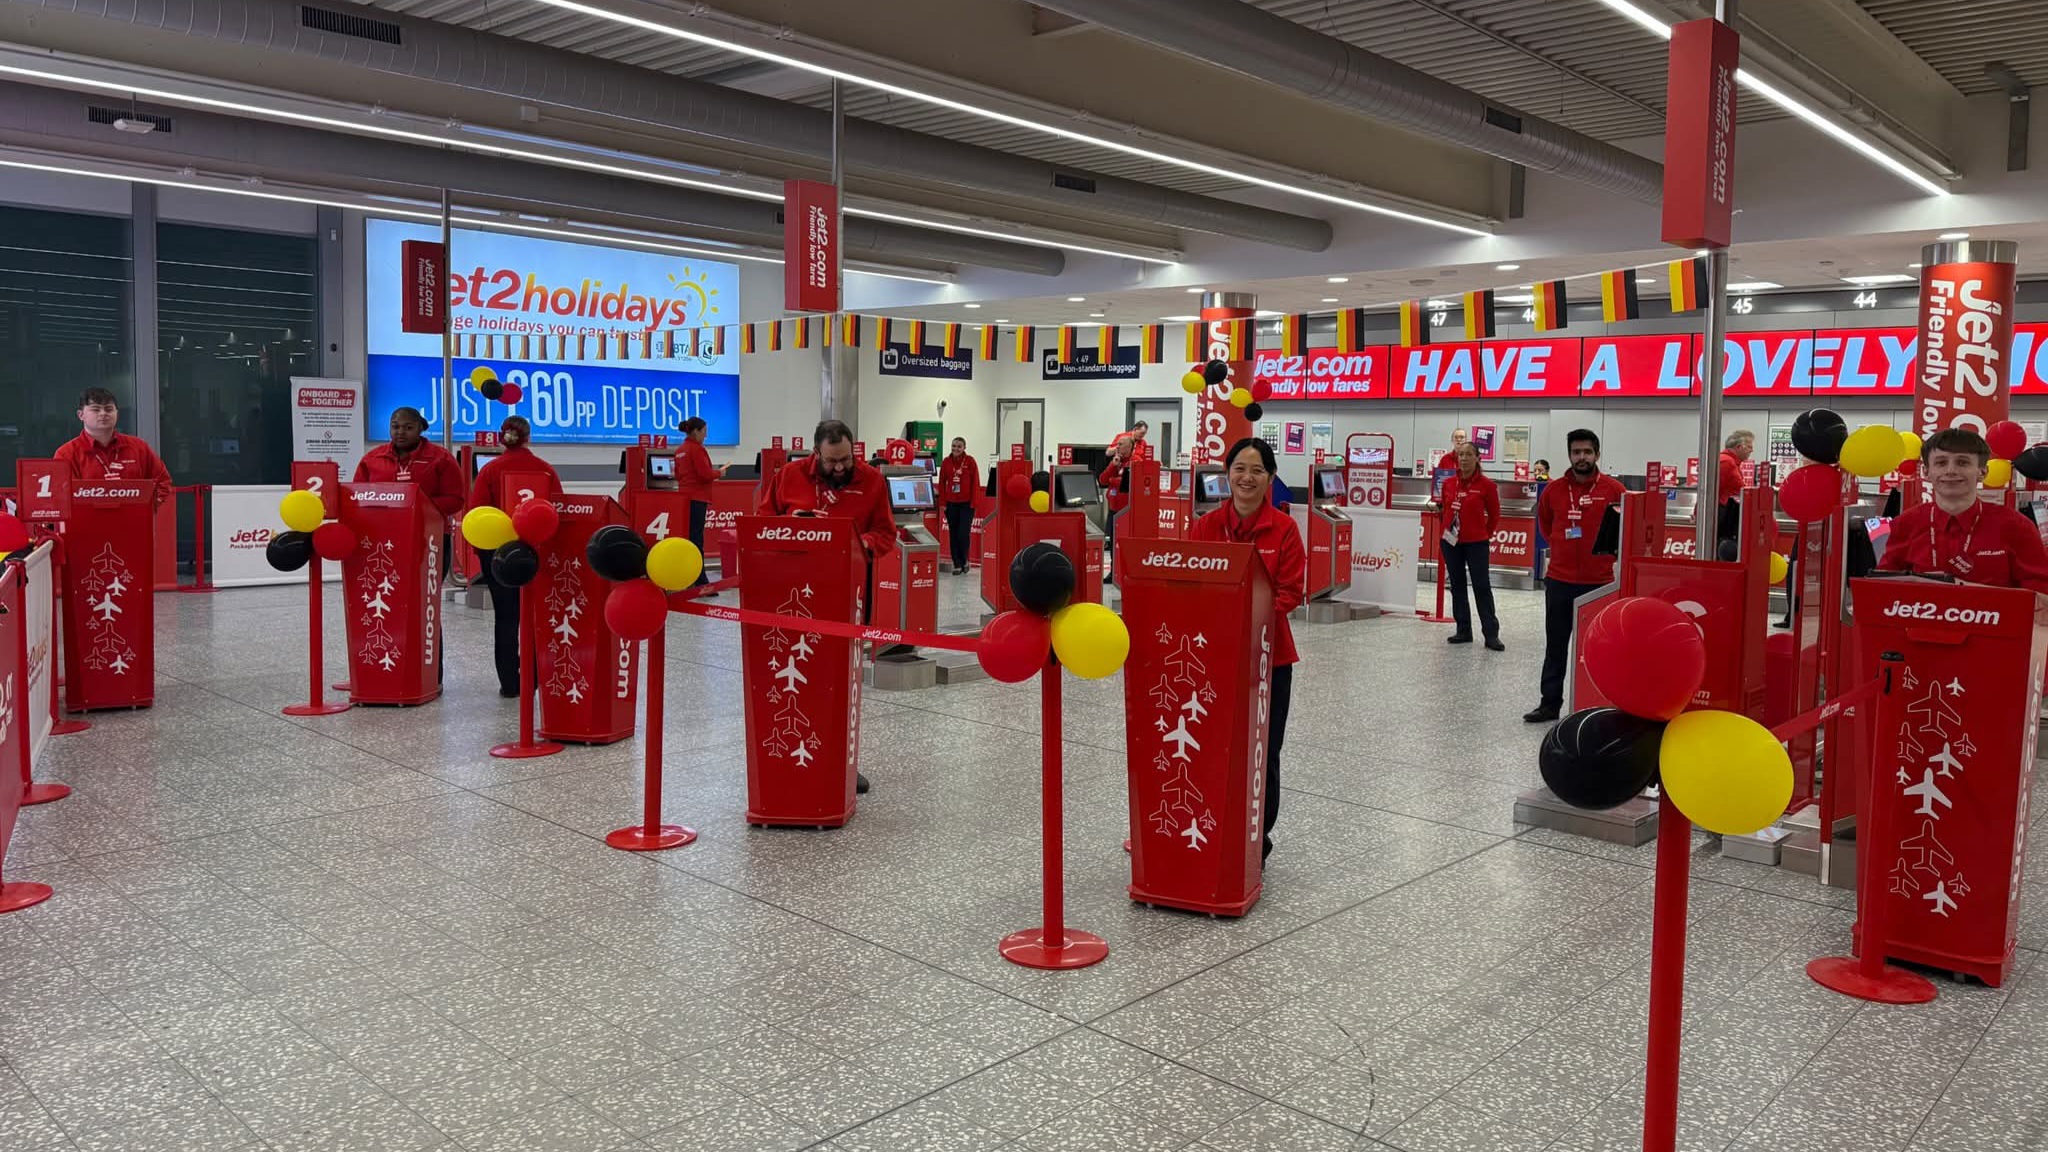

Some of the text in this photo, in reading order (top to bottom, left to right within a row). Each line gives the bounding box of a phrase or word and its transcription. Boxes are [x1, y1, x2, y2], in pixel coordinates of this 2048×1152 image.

[1715, 65, 1724, 125] Friendly
[1718, 68, 1731, 204] Jet2.com
[817, 207, 828, 288] Jet2.com
[425, 259, 435, 317] Jet2.com
[450, 266, 689, 333] et2holidays
[1731, 297, 1754, 314] 45
[1853, 291, 1878, 309] 44
[477, 315, 544, 336] holidays
[548, 322, 576, 337] you
[1430, 311, 1448, 327] 47
[1273, 321, 1284, 335] 4
[1922, 279, 1956, 392] Friendly
[901, 354, 971, 371] Oversized baggage
[1403, 335, 1918, 393] HAVE A LOVELY
[1950, 279, 2003, 438] Jet2.c
[1063, 362, 1137, 374] Non-standard baggage
[300, 390, 340, 398] ONBOARD
[1204, 320, 1235, 466] Je2.co
[1271, 378, 1300, 395] ndly
[1333, 378, 1370, 393] fares
[312, 398, 353, 406] TOGETHER
[484, 431, 494, 444] 8
[656, 435, 665, 446] 7
[794, 437, 802, 447] 6
[890, 446, 906, 460] 16
[1060, 447, 1073, 460] 15
[36, 474, 52, 498] 1
[73, 486, 140, 499] Jet2.com
[306, 476, 324, 497] 2
[350, 491, 405, 501] Jet2.com
[645, 511, 670, 541] 4
[756, 526, 833, 542] Jet2.com
[1499, 544, 1526, 556] fares
[1141, 551, 1230, 571] Jet2.com
[424, 535, 438, 666] Jet2.com
[705, 607, 740, 621] Jet2.com
[1883, 600, 2001, 626] Jet2.com
[861, 628, 902, 642] Jet2.com
[1250, 624, 1271, 842] Jet2.com
[2011, 661, 2041, 901] Jet2.com
